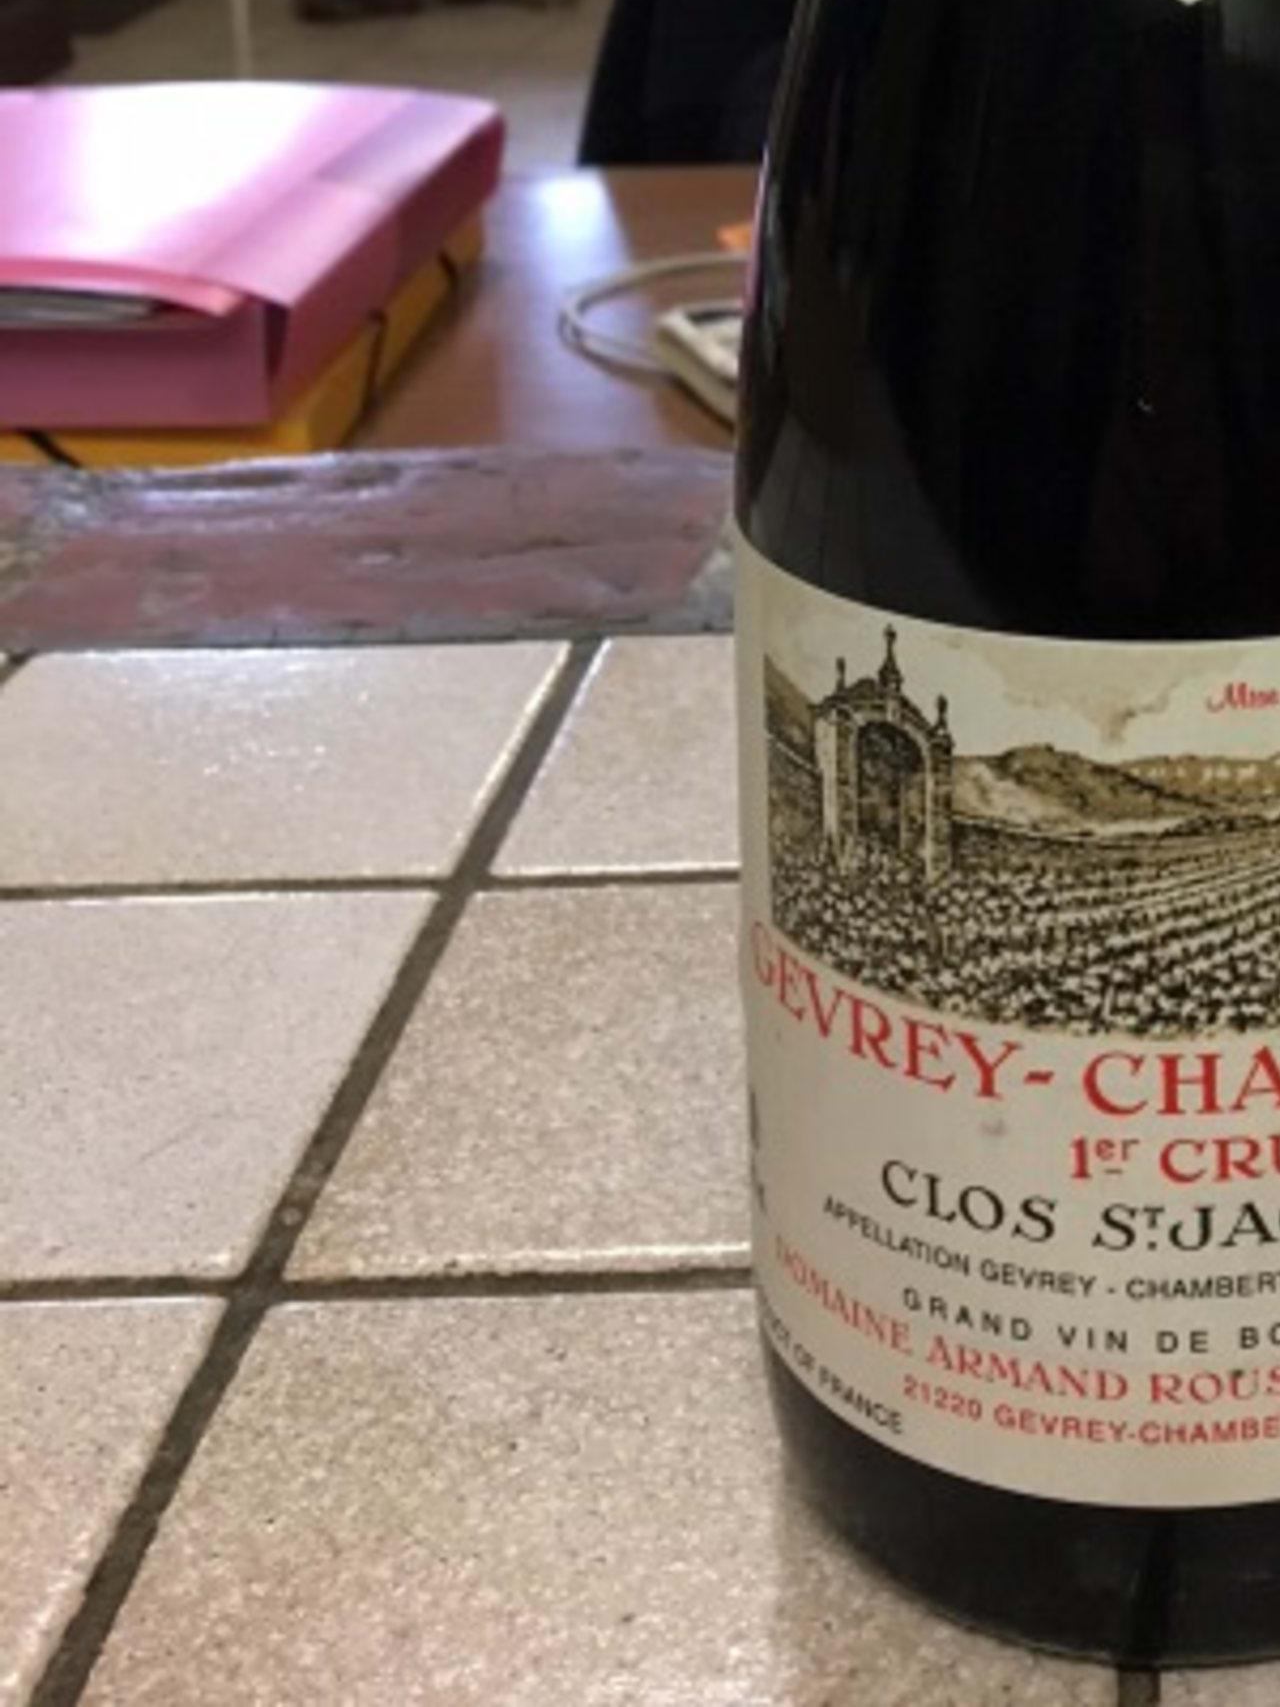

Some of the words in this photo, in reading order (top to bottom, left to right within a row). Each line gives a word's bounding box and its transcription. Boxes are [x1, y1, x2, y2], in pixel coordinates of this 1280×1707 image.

[1206, 683, 1280, 713] Mise
[1071, 1135, 1140, 1180] 1er
[881, 1160, 1057, 1243] CLOS
[822, 1194, 971, 1277] APPELLATION
[980, 1256, 1098, 1296] GEVREY
[776, 1235, 913, 1357] DOMAINE
[925, 1335, 1129, 1402] ARMAND
[903, 1287, 1033, 1342] GRAND
[1057, 1324, 1129, 1354] VIN
[1156, 1329, 1209, 1355] DE
[817, 1363, 904, 1436] FRANCE
[903, 1374, 983, 1422] 21220
